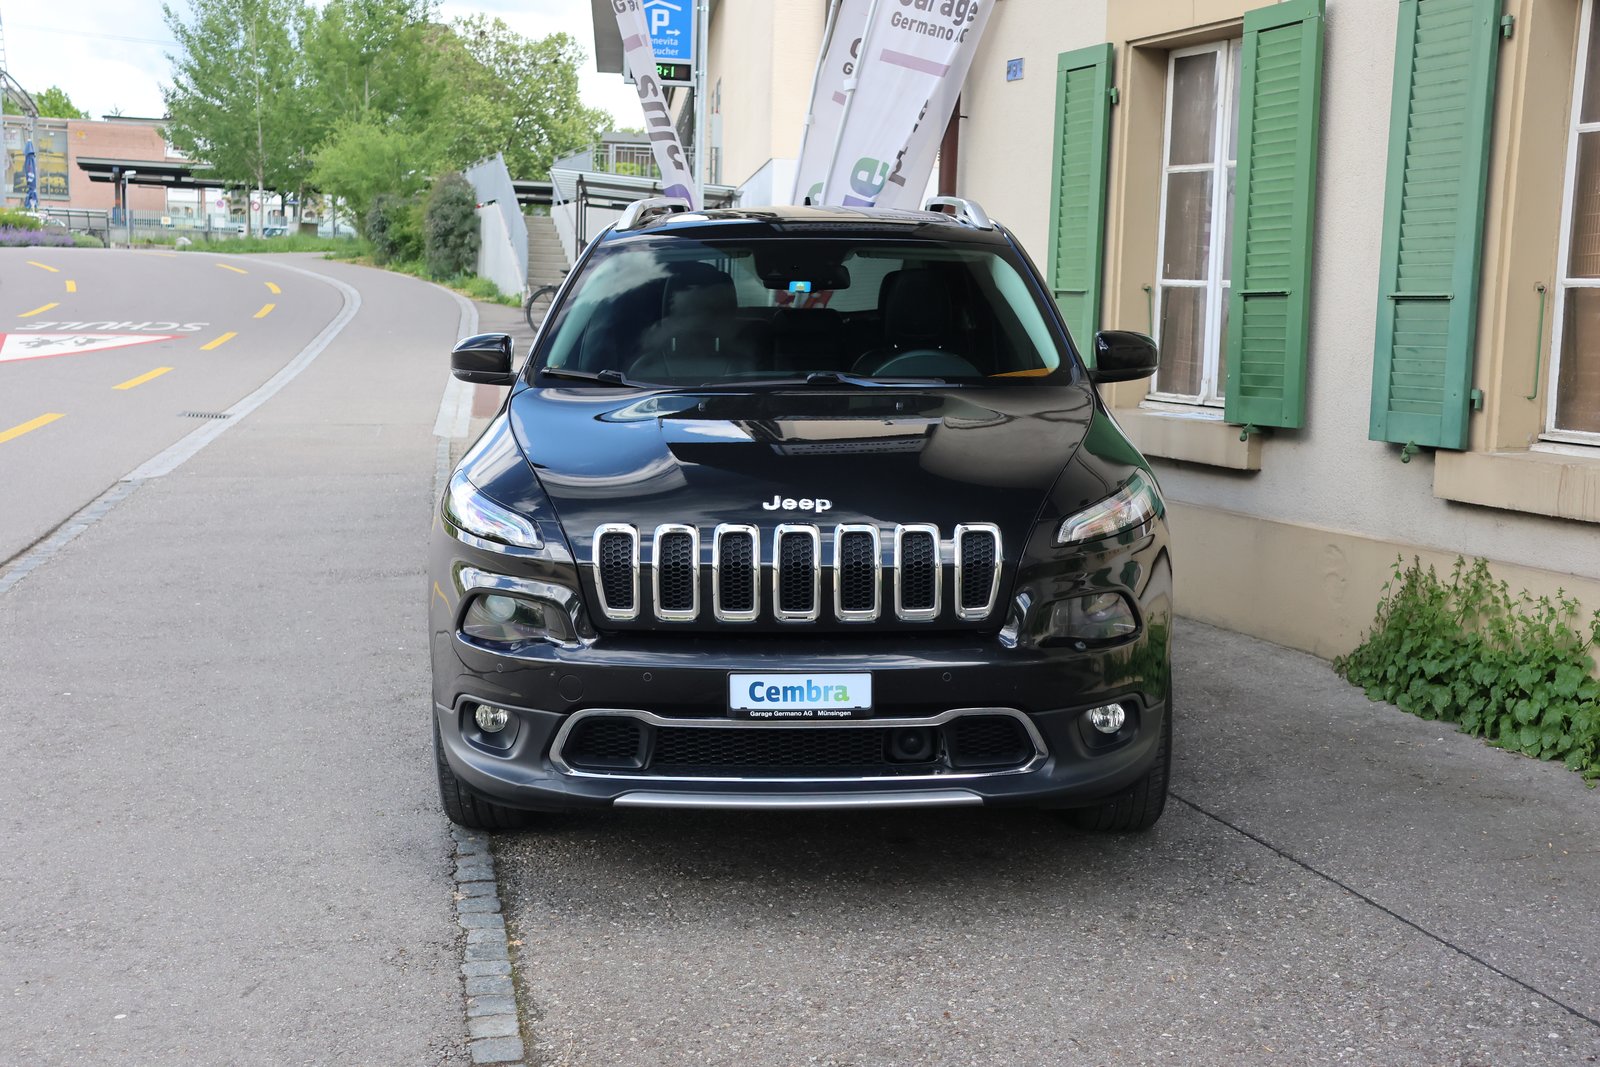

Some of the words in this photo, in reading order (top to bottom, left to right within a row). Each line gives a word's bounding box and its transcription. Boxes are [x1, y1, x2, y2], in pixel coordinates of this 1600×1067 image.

[651, 8, 670, 36] P
[891, 11, 954, 41] Germano
[15, 321, 210, 332] SCHULE
[762, 495, 832, 513] Jeep
[748, 679, 850, 703] Cembra
[750, 710, 773, 718] Garage
[817, 709, 852, 717] Münsingen
